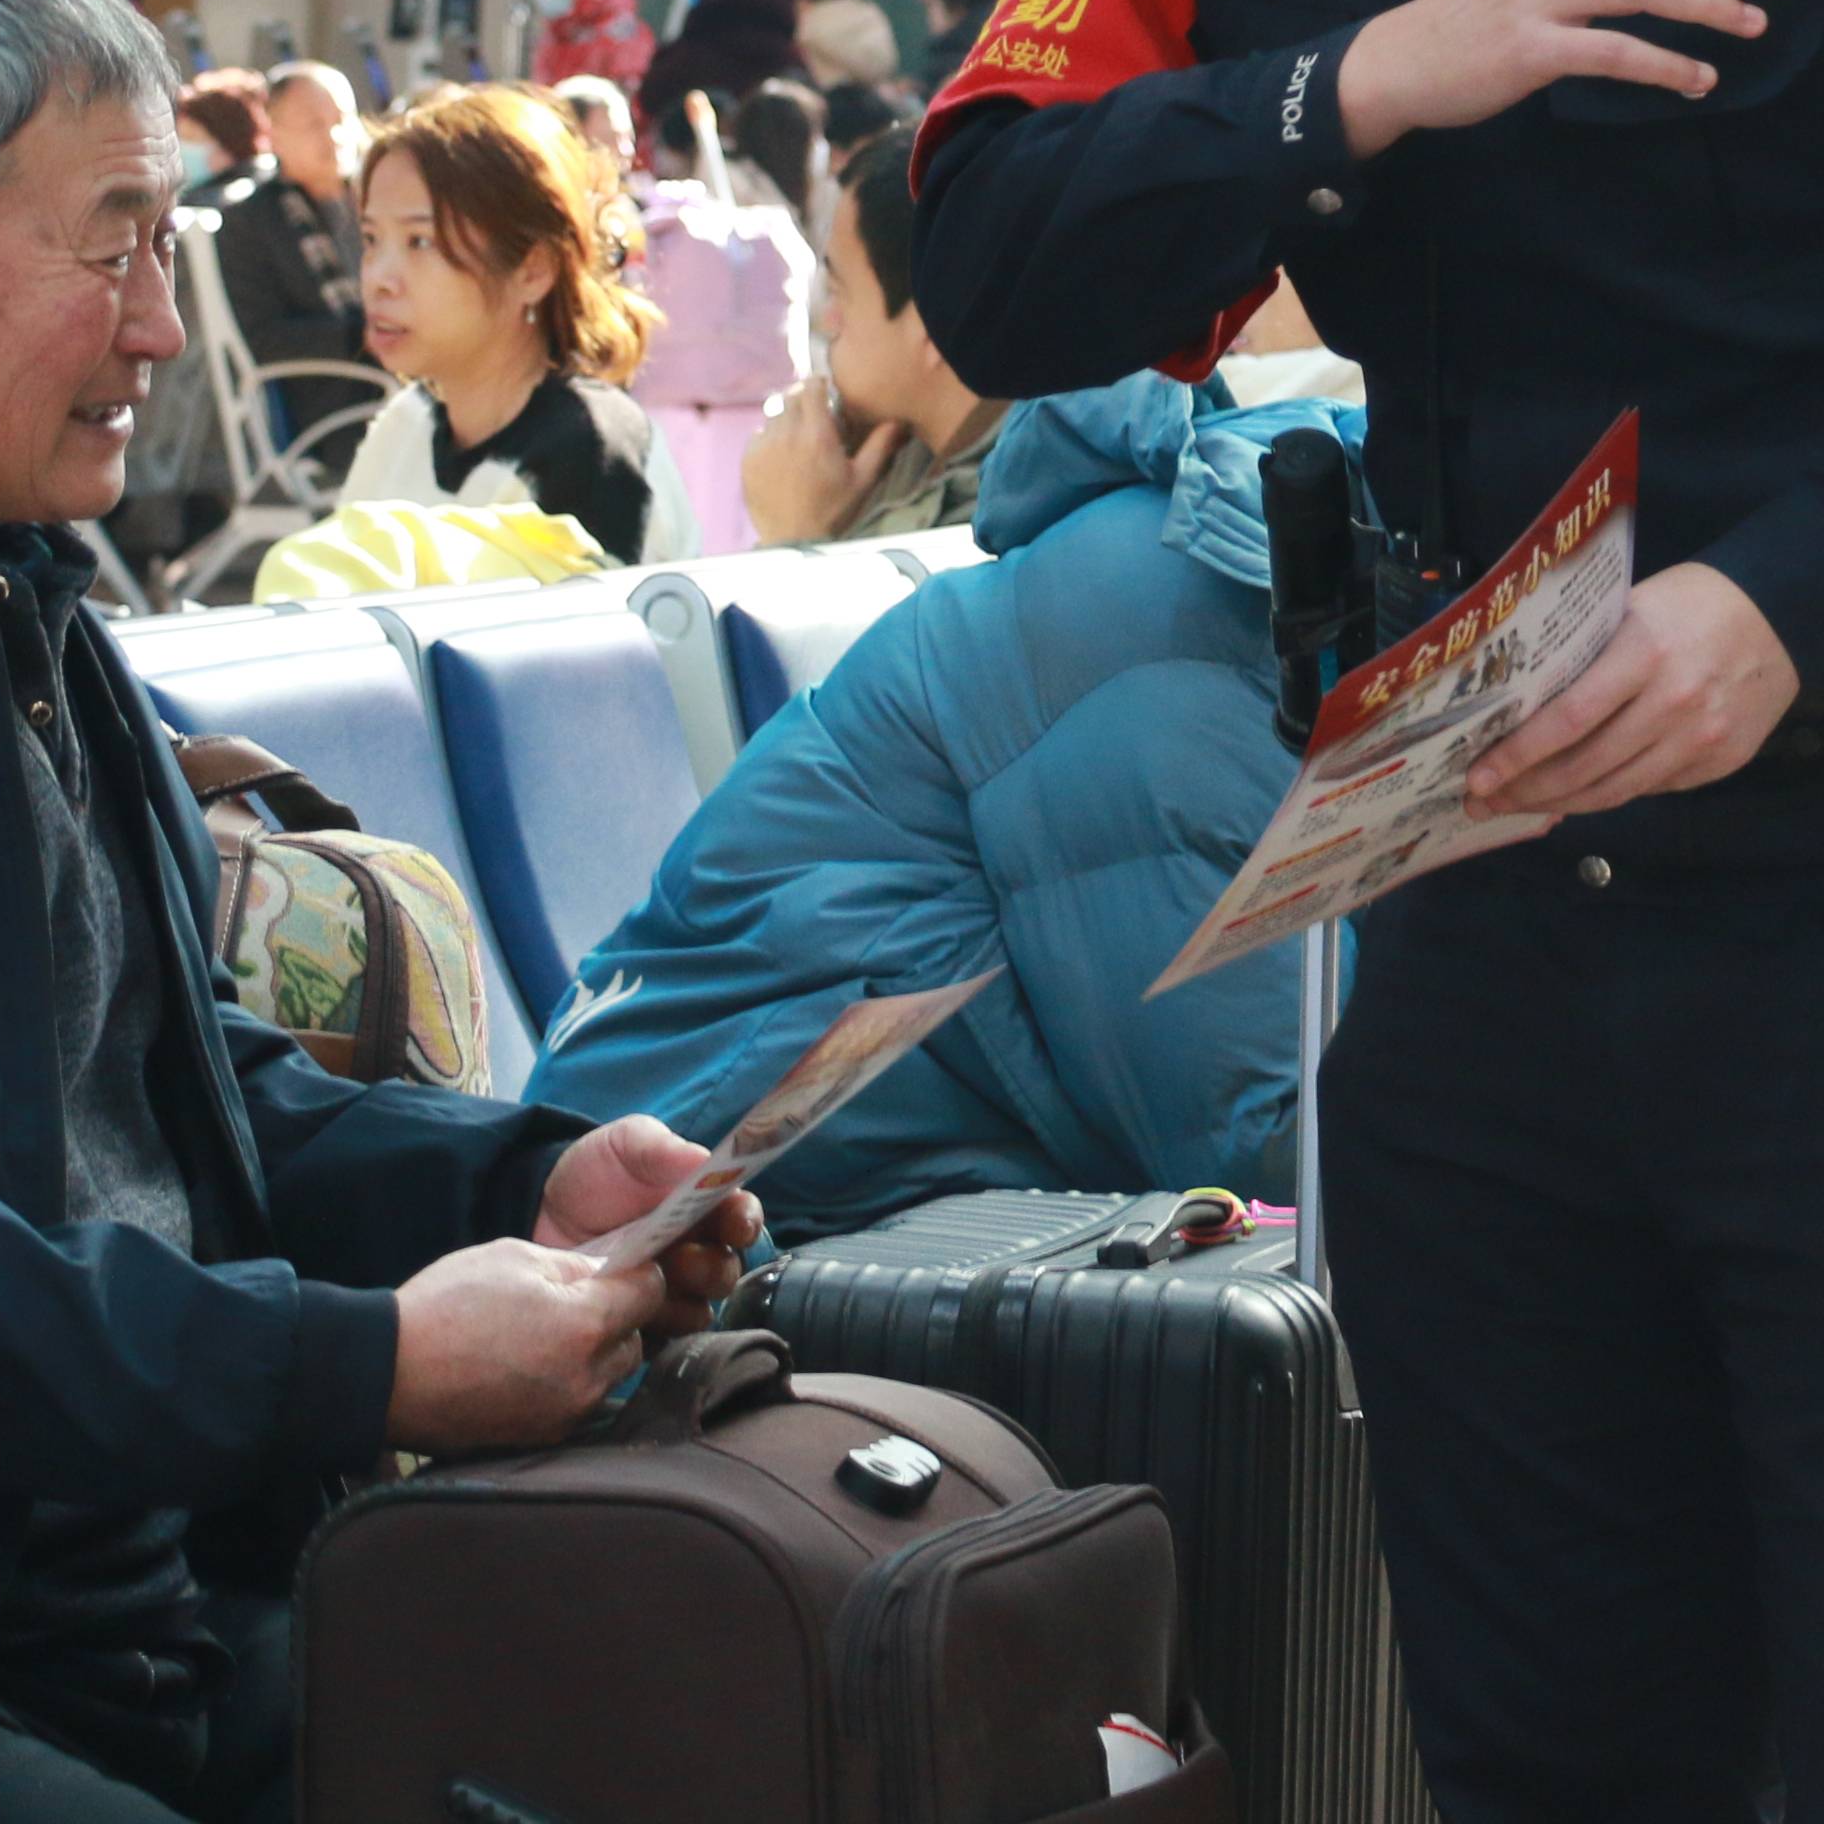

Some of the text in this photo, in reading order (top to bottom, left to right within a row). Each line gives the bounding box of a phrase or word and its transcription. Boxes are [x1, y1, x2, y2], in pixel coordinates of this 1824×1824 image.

[968, 34, 1071, 80] 公安处
[1281, 51, 1321, 143] POLICE
[1358, 466, 1613, 716] 安全防范小知识
